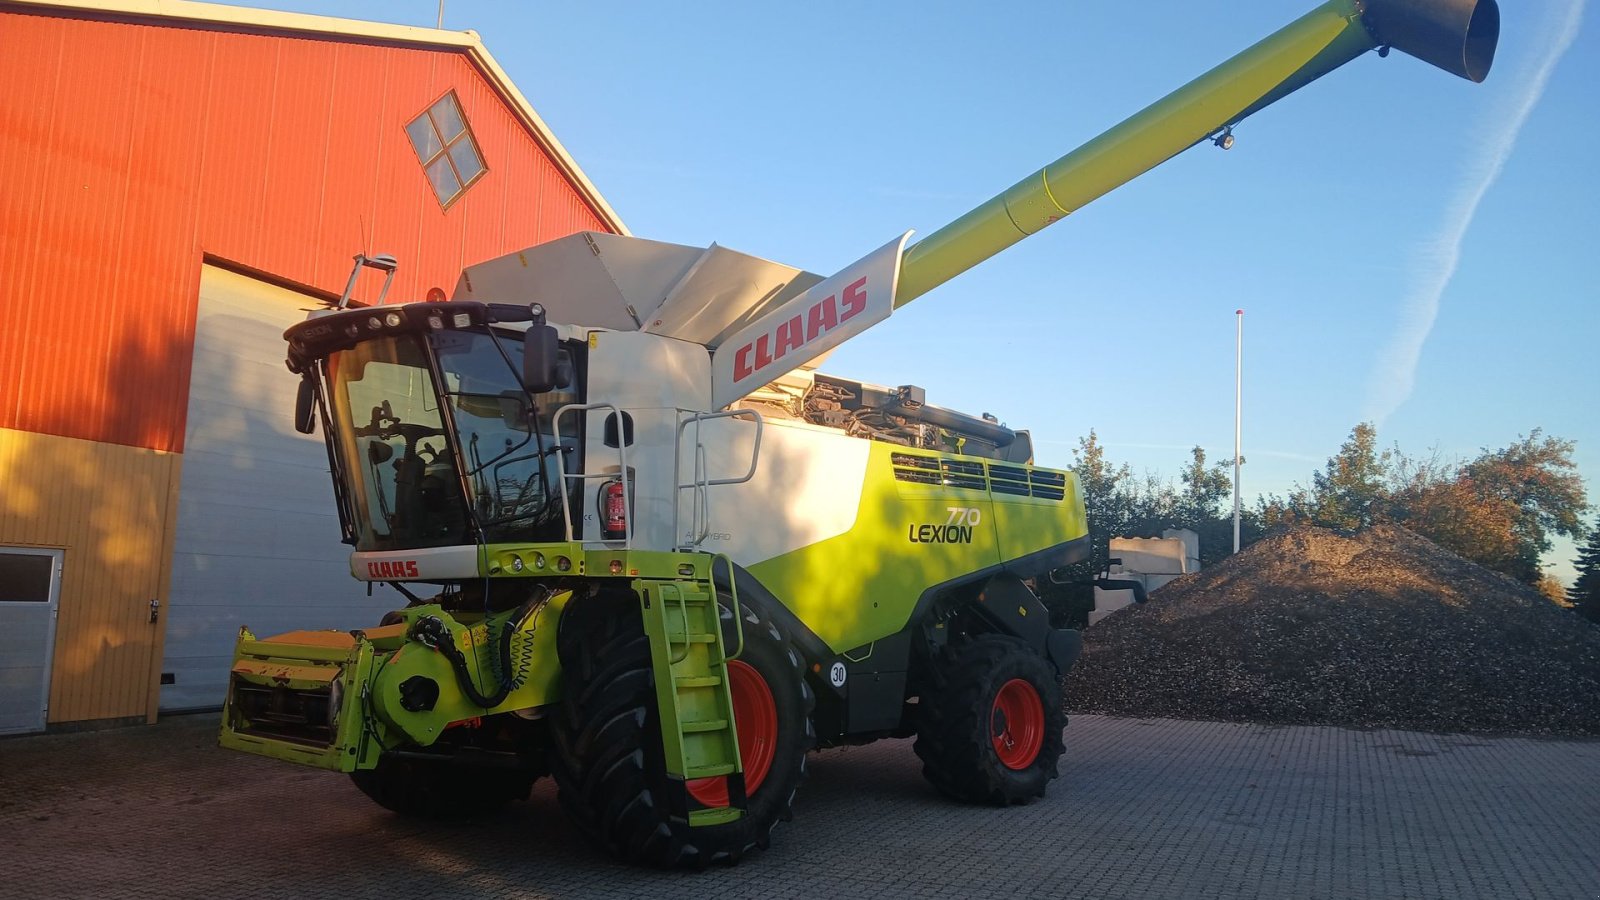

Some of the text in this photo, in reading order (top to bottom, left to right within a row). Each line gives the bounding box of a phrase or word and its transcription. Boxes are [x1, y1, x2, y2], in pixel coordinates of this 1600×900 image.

[733, 276, 867, 383] CLAAS
[947, 507, 981, 526] 770
[909, 524, 973, 543] LEXION
[368, 561, 418, 578] CLAAS
[833, 667, 843, 681] 30
